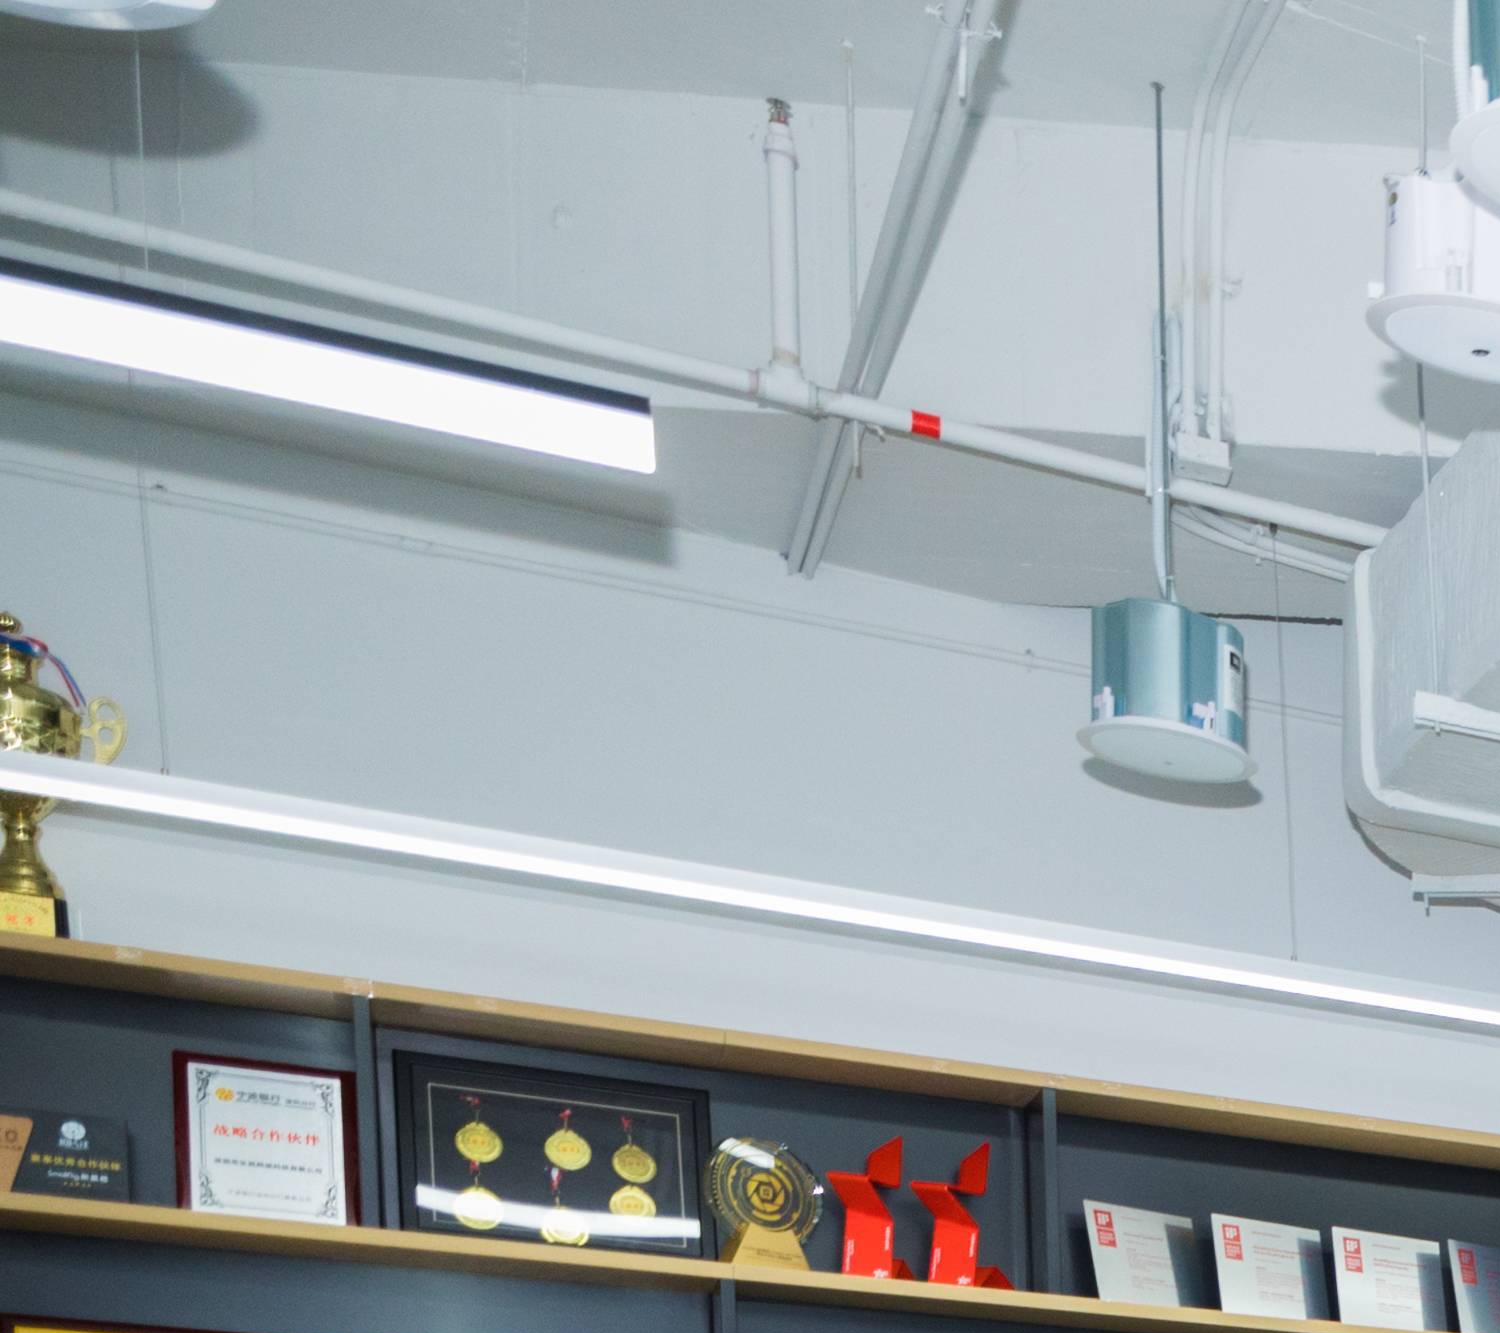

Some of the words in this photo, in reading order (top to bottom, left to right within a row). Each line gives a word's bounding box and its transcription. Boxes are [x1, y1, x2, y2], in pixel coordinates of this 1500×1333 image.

[213, 1123, 321, 1147] 战略合作伙伴
